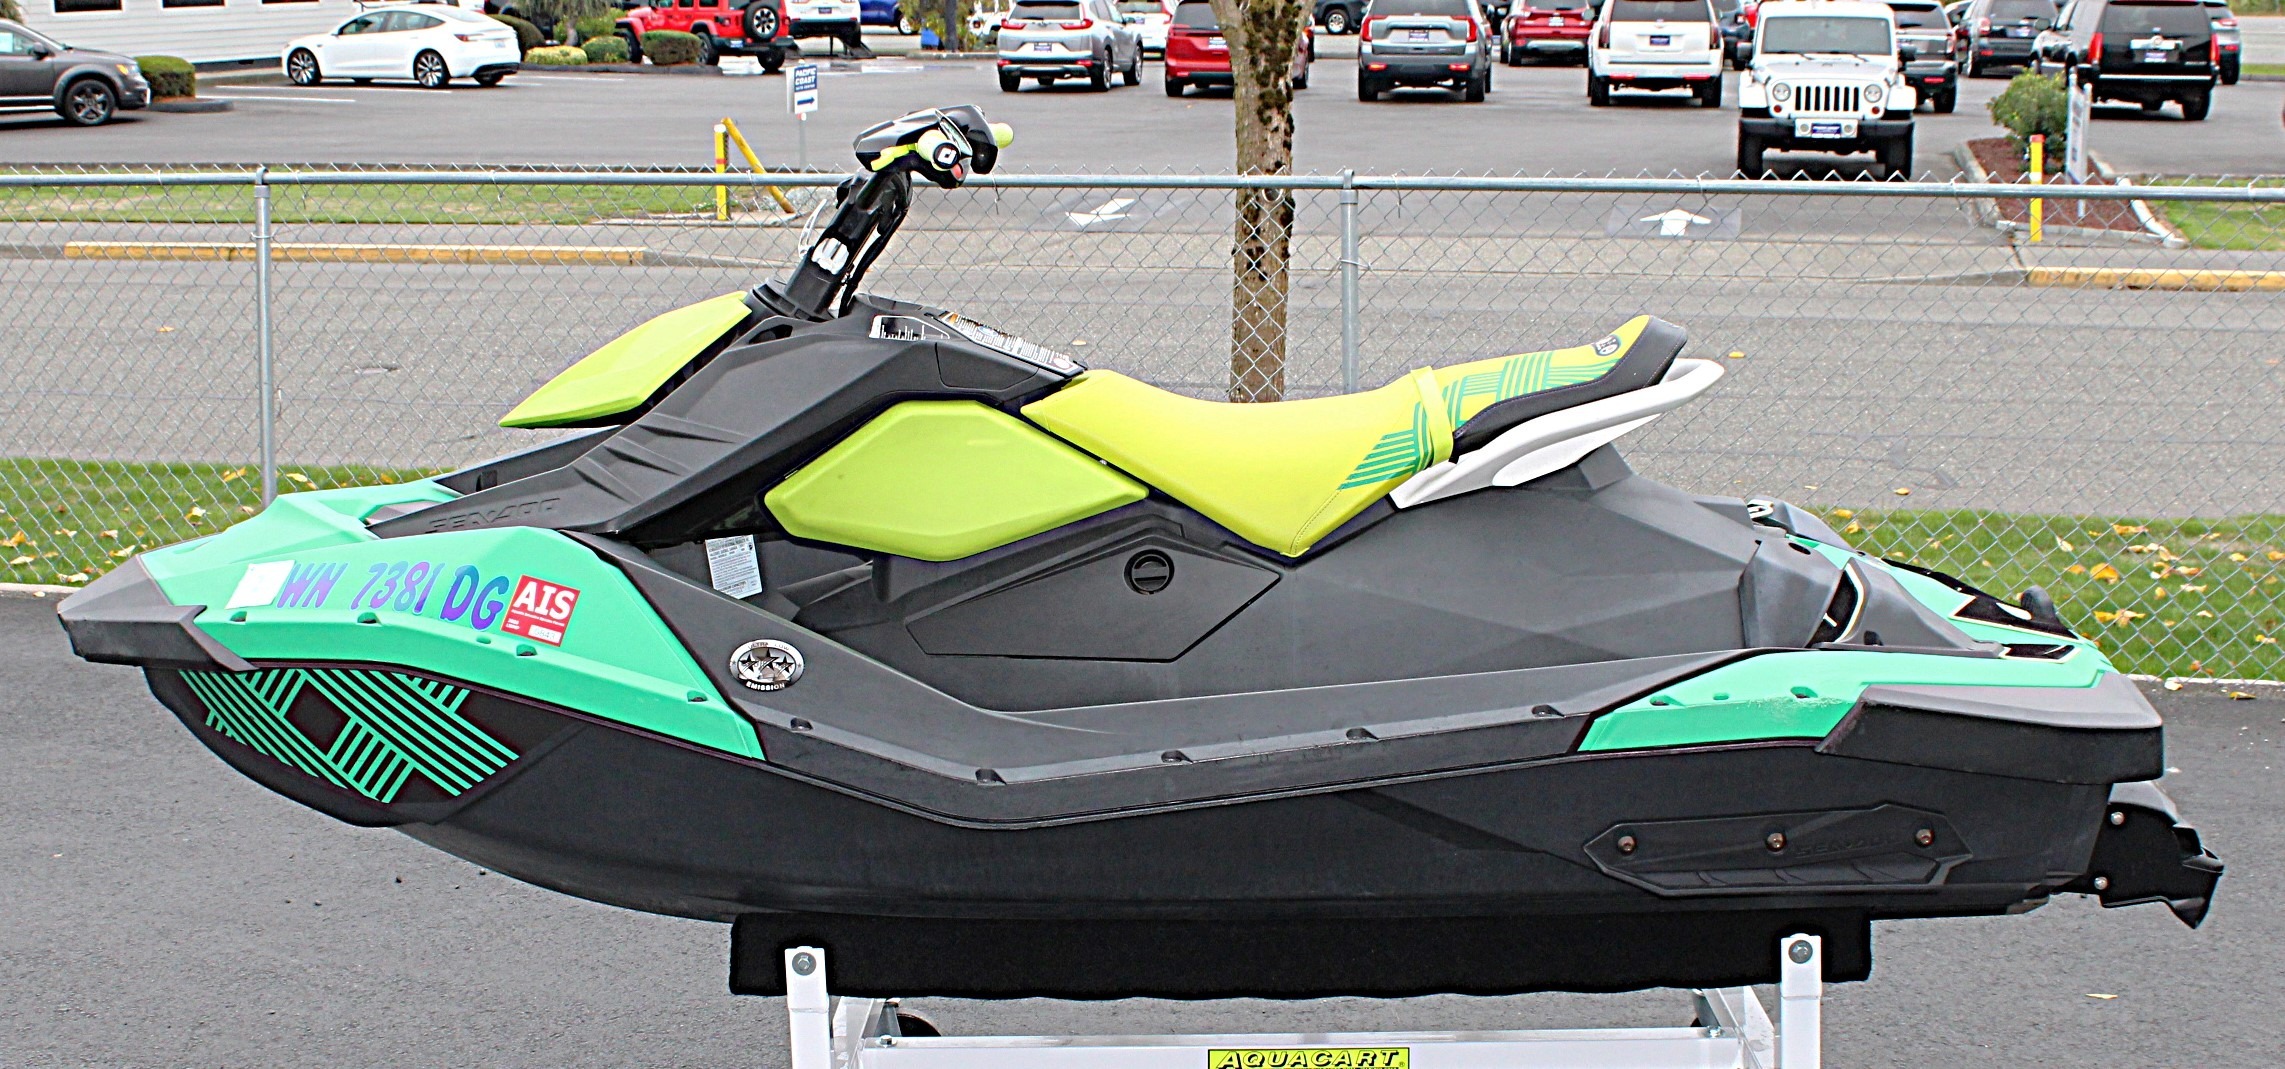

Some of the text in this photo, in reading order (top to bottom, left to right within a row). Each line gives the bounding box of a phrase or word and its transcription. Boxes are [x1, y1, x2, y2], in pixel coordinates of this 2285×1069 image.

[795, 68, 817, 77] PACIFIC
[795, 76, 816, 85] COAST
[276, 560, 510, 630] WN 7381 DG
[512, 581, 576, 620] AIS
[748, 642, 769, 650] ULTRA
[745, 681, 785, 691] EMISSION
[1216, 1050, 1400, 1069] AQUACART
